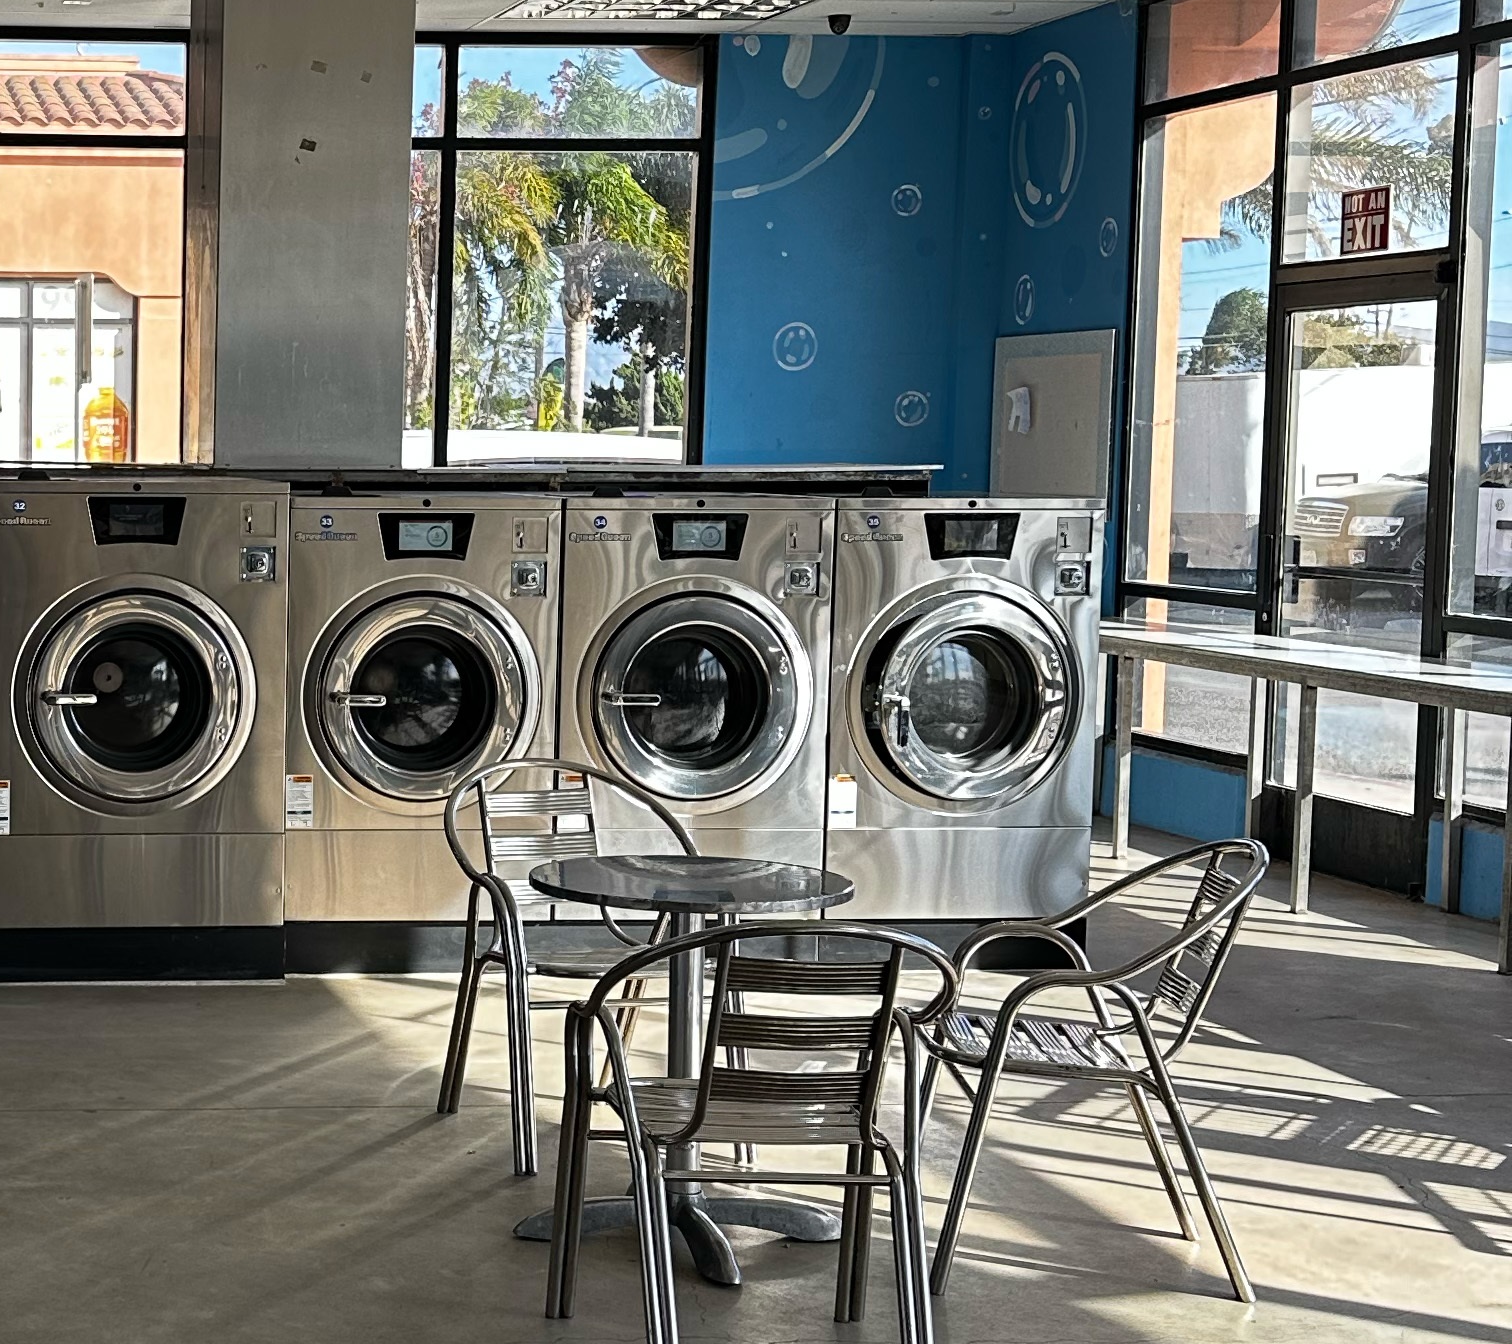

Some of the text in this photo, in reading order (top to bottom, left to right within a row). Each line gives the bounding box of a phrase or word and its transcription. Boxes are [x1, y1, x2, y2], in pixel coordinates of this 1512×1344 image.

[1344, 190, 1386, 214] NOT AN
[1343, 214, 1385, 251] EXIT
[13, 502, 26, 510] 32
[321, 517, 333, 526] 33
[595, 518, 606, 526] 34
